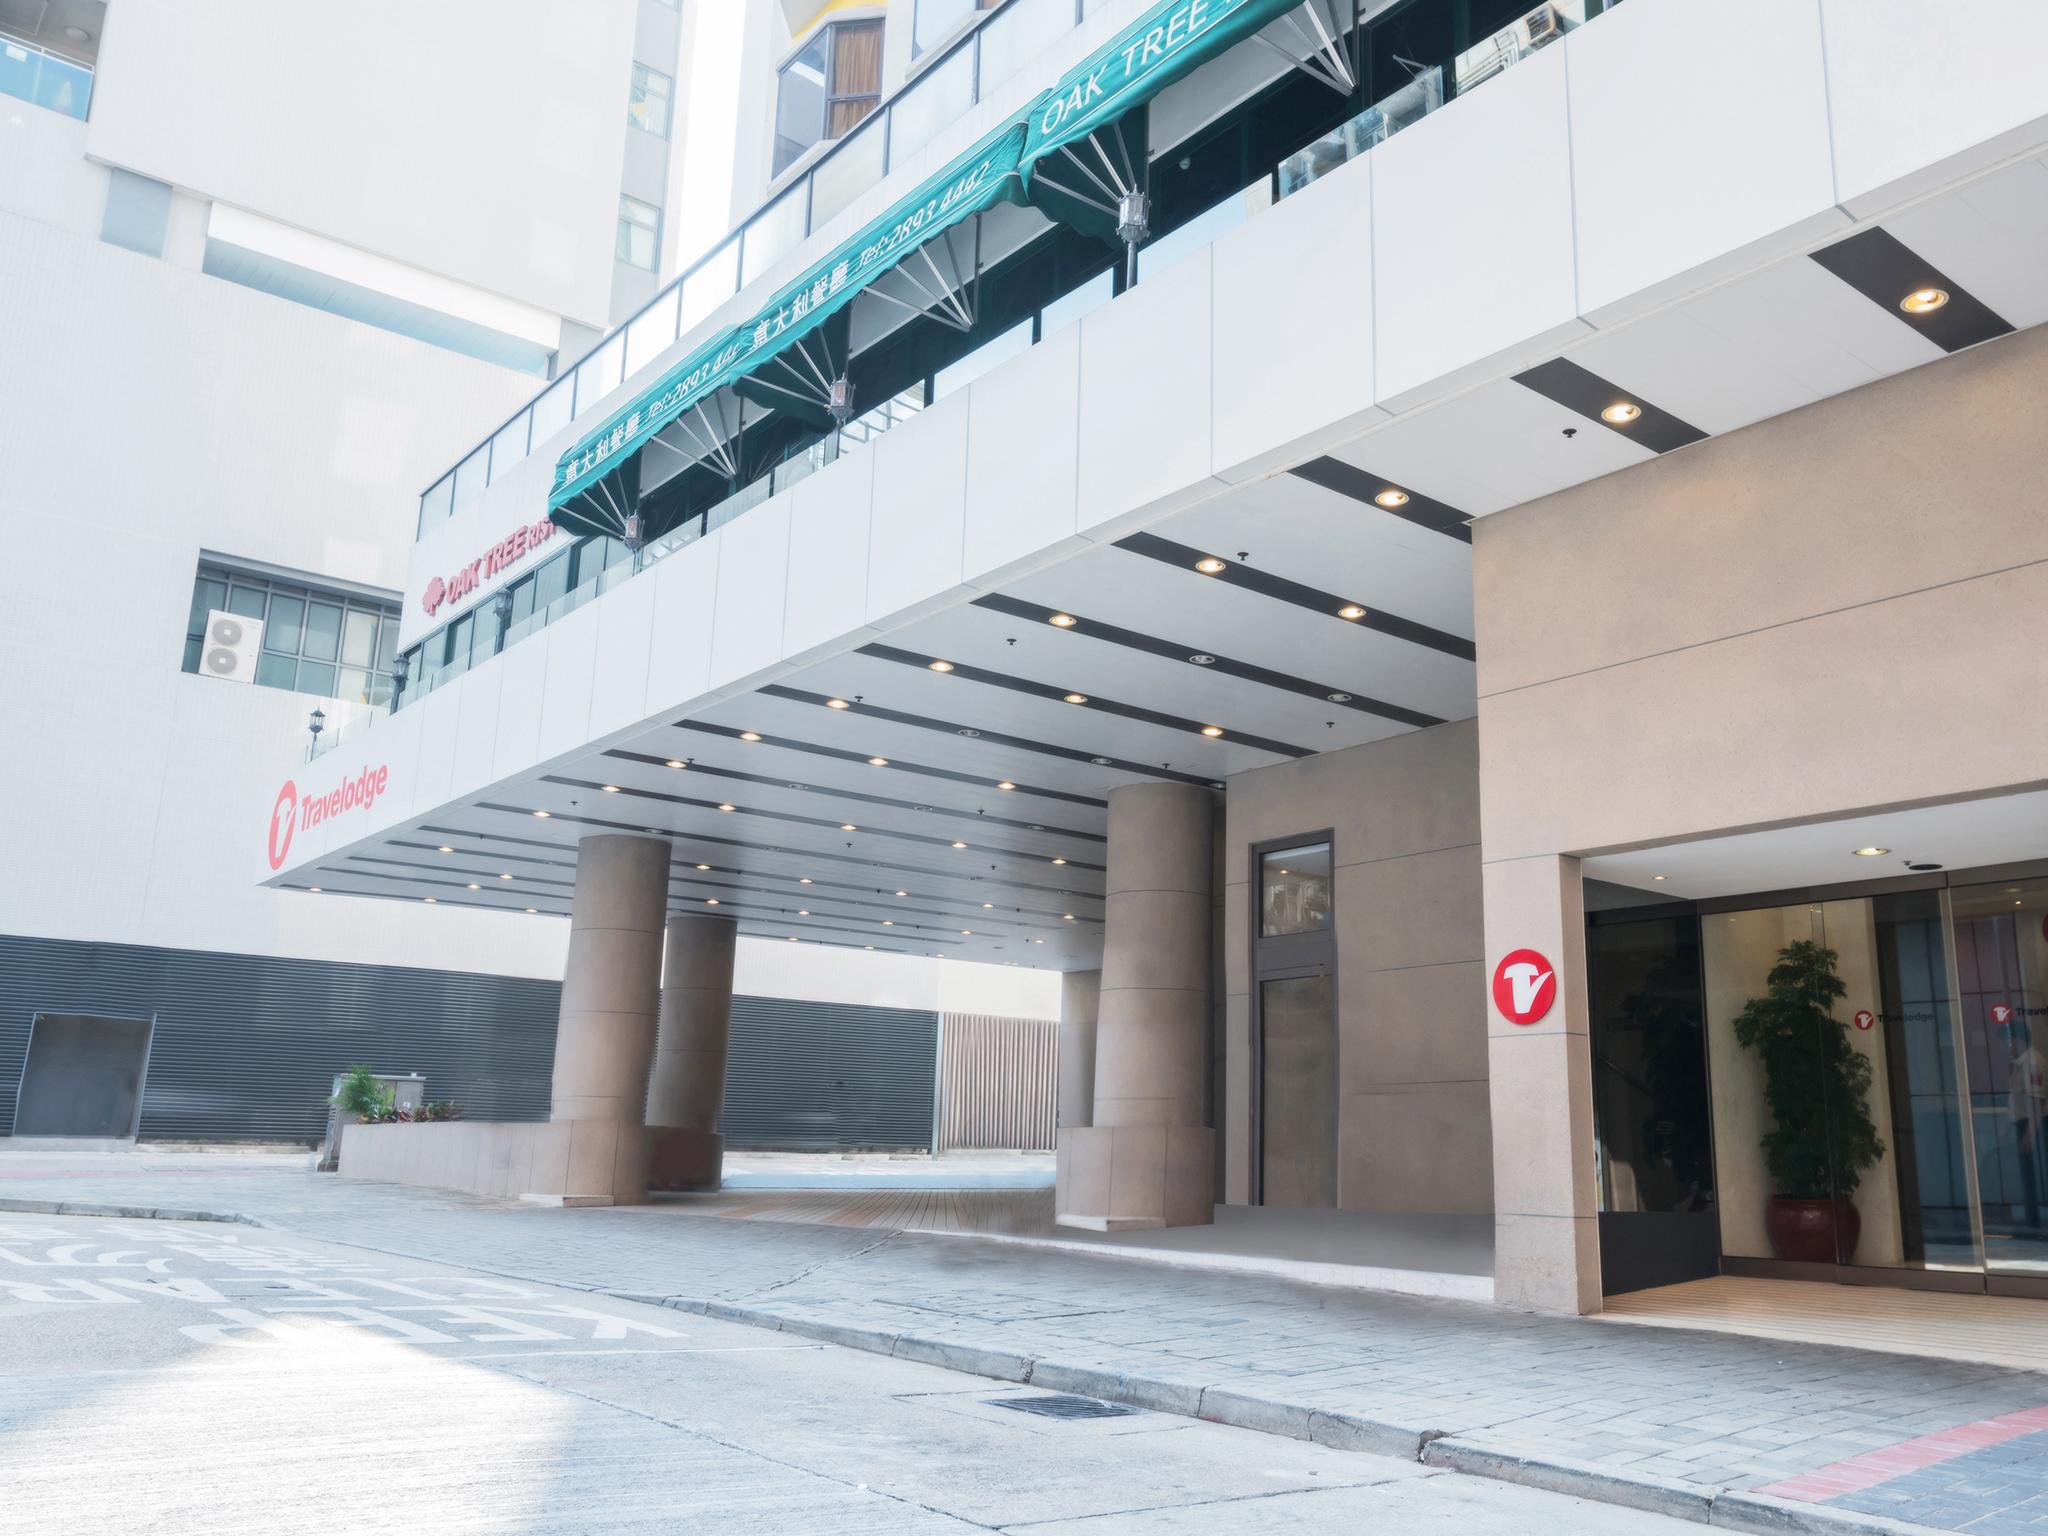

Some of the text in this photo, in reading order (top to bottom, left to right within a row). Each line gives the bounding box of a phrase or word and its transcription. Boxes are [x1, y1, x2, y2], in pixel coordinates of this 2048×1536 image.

[1041, 0, 1209, 134] OAK TREE
[941, 161, 990, 212] 4442
[446, 558, 482, 605] OAK
[484, 525, 528, 579] TREE
[301, 765, 388, 832] Travelodge
[0, 1277, 552, 1304] CLEAR
[179, 1304, 690, 1348] KEEP
